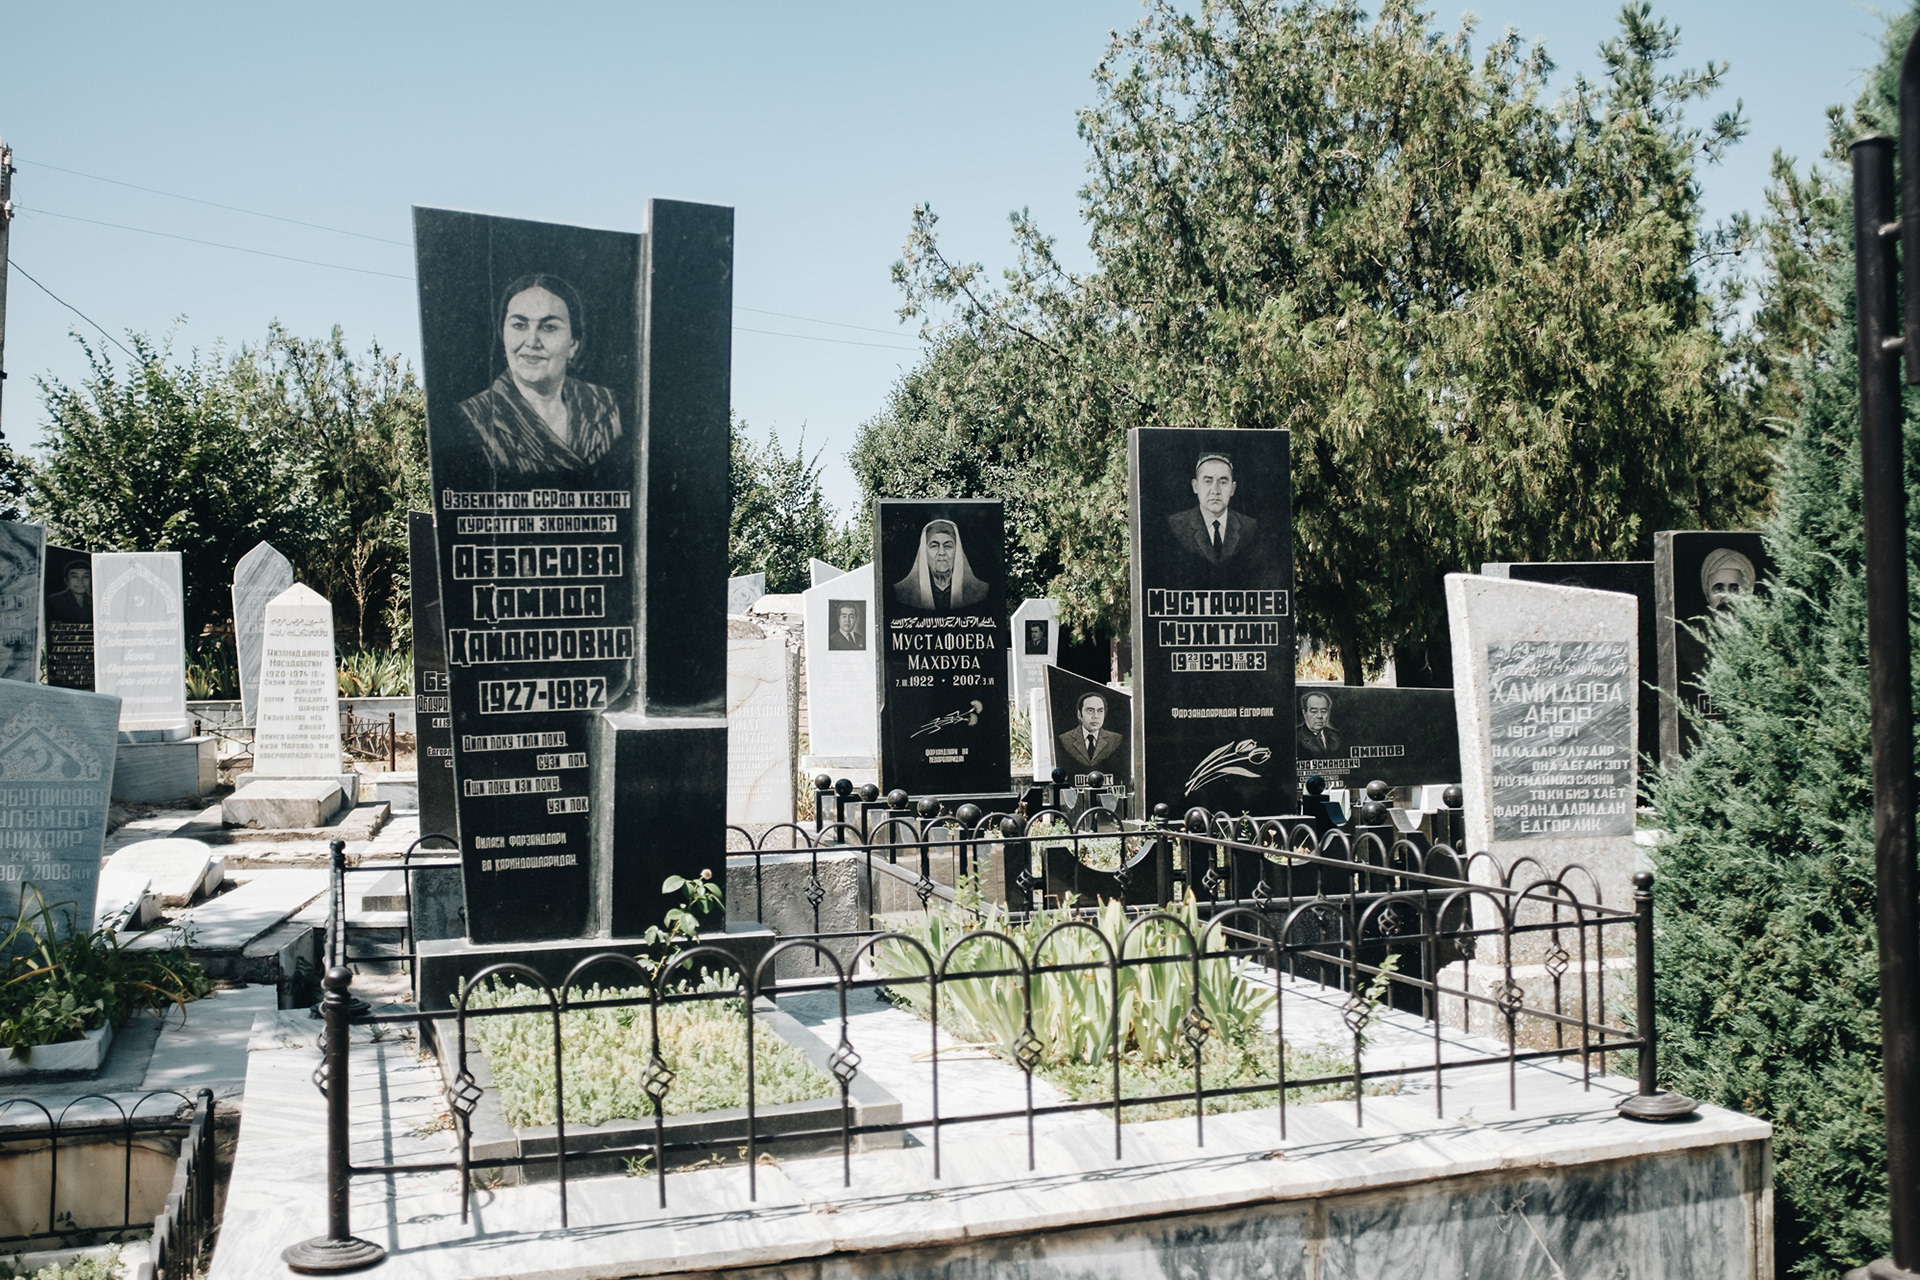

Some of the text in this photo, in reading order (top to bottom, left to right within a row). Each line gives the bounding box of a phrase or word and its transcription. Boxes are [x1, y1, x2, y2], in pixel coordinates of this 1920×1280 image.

[453, 545, 622, 579] АББОСОВА
[1148, 588, 1288, 617] МУСТАФАЕВ
[1159, 621, 1278, 647] МУХИТДИН
[479, 677, 607, 714] 1927-1982
[1524, 705, 1592, 723] АНОР
[1560, 760, 1602, 770] ДЕГАН
[1493, 802, 1626, 818] ФАРЗАНДЛАРИДАН
[1521, 818, 1601, 833] ЁДГОРЛИК
